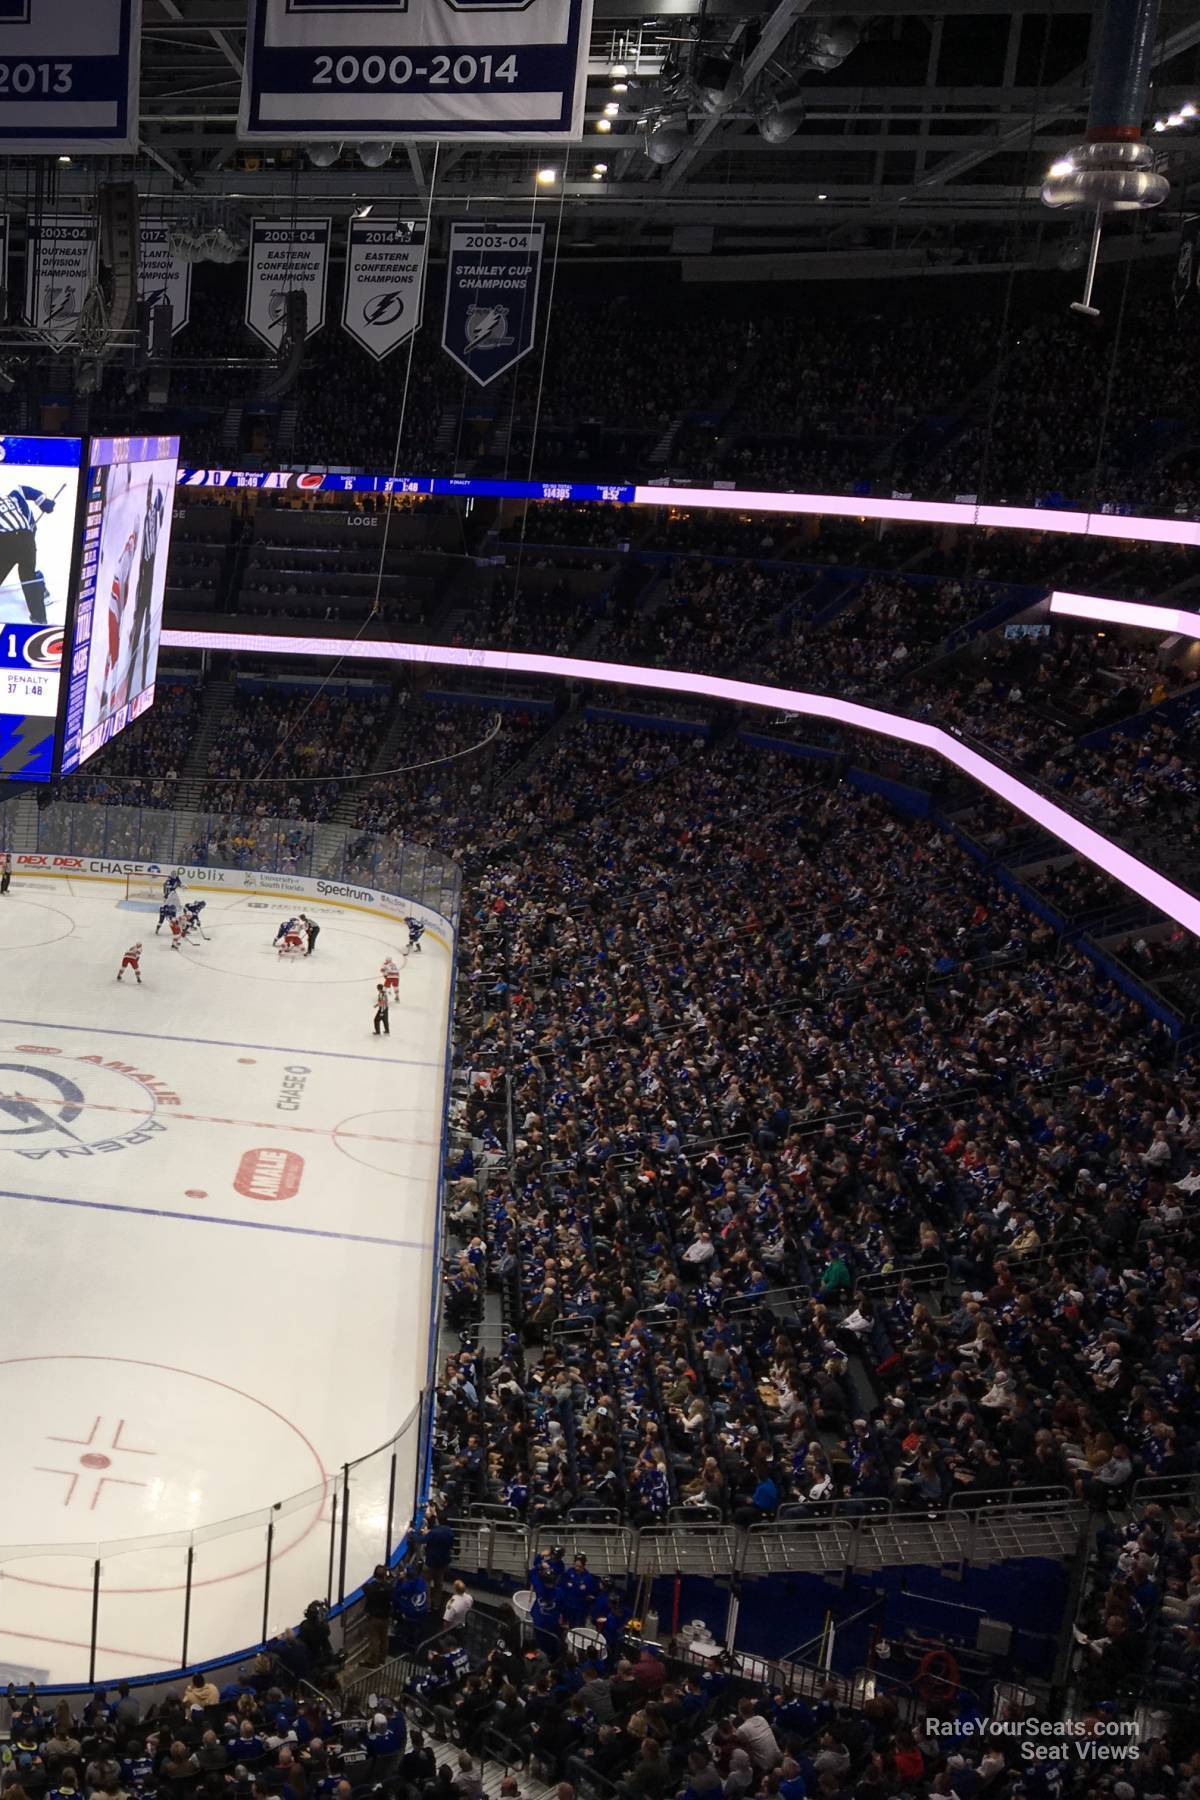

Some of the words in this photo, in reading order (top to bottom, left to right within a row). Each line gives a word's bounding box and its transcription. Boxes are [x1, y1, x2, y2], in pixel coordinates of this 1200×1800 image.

[312, 54, 519, 85] 2000-2014
[41, 228, 87, 238] 2003-04
[465, 236, 527, 248] 2003-04
[268, 251, 311, 260] EASTERN
[365, 252, 409, 261] EASTERN
[42, 258, 81, 266] DIVISION
[257, 262, 321, 270] CONFERENCE
[354, 263, 419, 272] CONFERENCE
[455, 265, 506, 276] STANLEY
[508, 266, 532, 276] CUP
[260, 273, 316, 281] CHAMPIONS
[357, 275, 414, 283] CHAMPIONS
[459, 278, 527, 289] CHAMPIONS
[344, 481, 353, 491] 15
[347, 516, 378, 527] LOGE
[7, 633, 17, 658] 1
[7, 675, 49, 686] PENALTY
[8, 684, 17, 694] 37
[16, 855, 49, 866] DEX
[52, 857, 84, 868] DEX
[89, 861, 144, 875] CHASE
[177, 866, 225, 882] Publix
[316, 880, 371, 903] Spectrum
[77, 1053, 182, 1106] AMALIE
[276, 1075, 308, 1112] CHASE
[14, 1120, 169, 1160] ARENA
[249, 1150, 288, 1198] AMALIE
